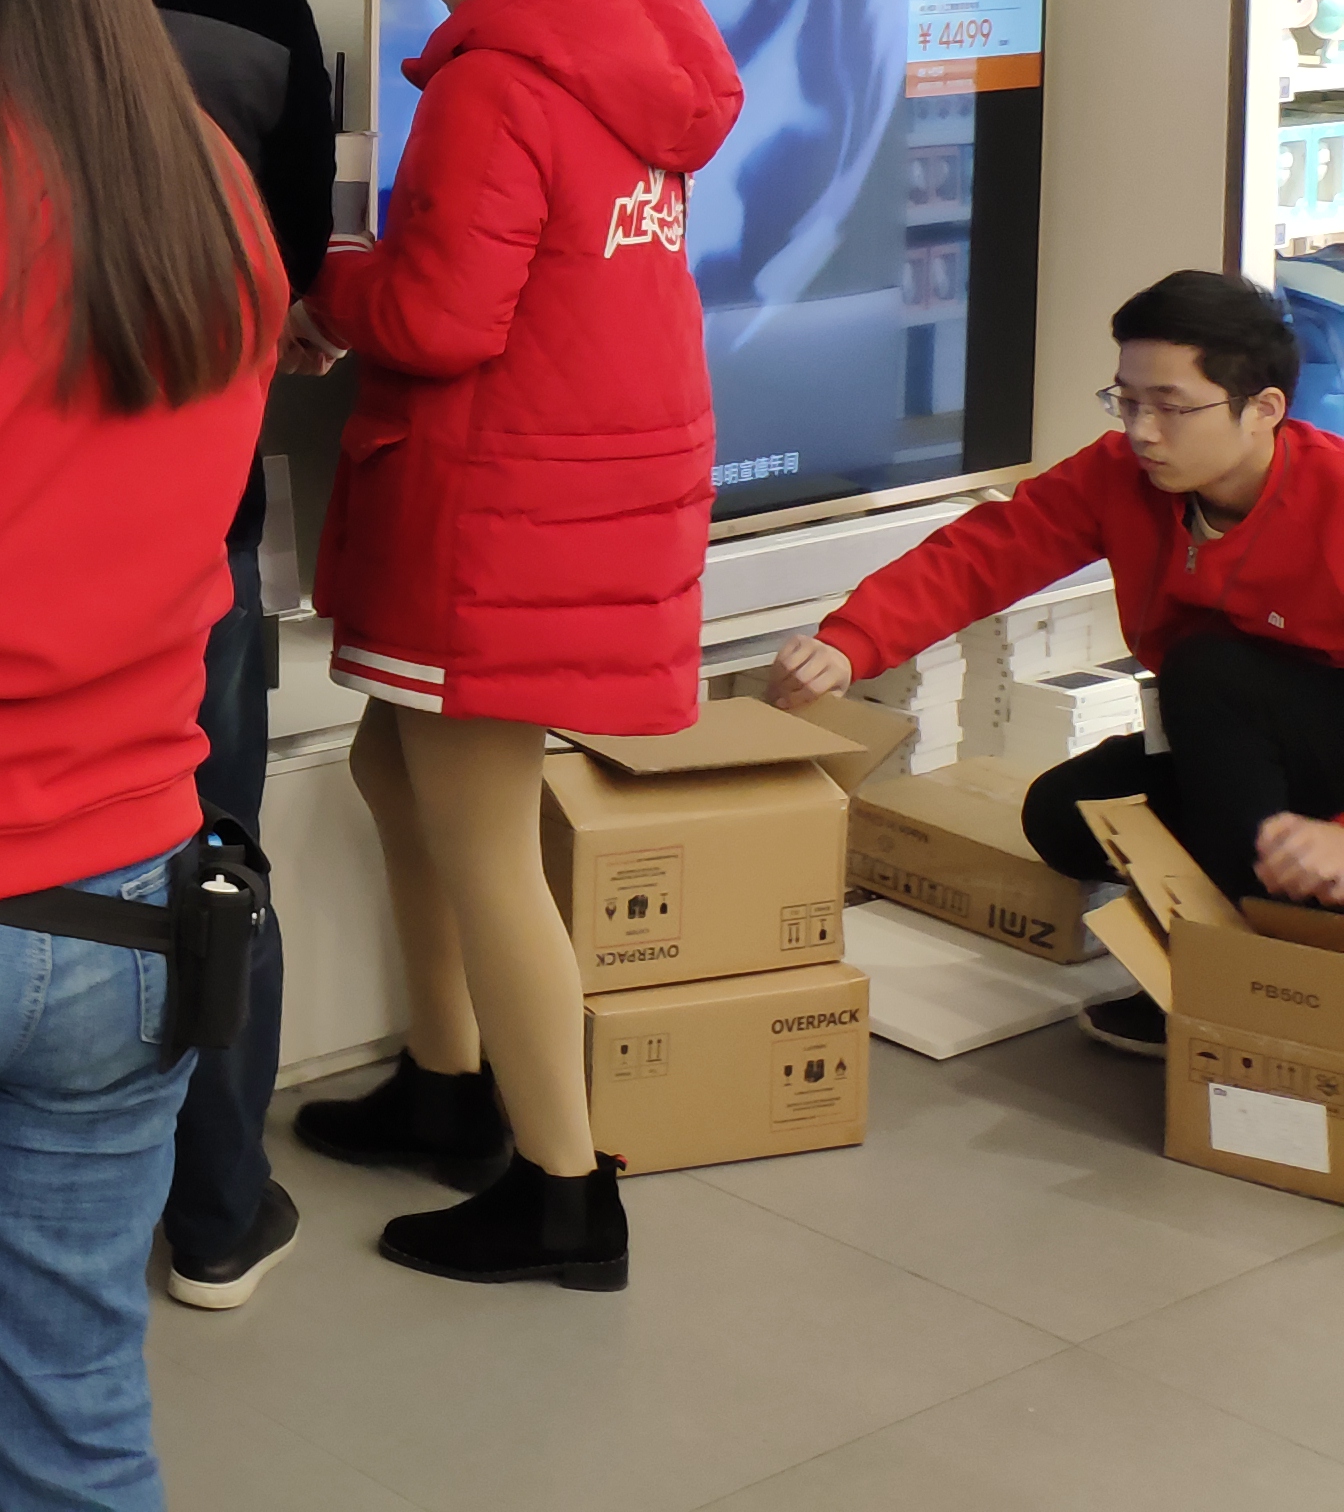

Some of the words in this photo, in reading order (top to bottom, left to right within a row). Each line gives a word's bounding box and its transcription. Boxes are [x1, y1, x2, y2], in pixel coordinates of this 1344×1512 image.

[939, 19, 993, 49] 4499
[595, 944, 680, 968] OVERPACK
[1250, 981, 1321, 1009] PB50C
[771, 1008, 860, 1035] OVERPACK
